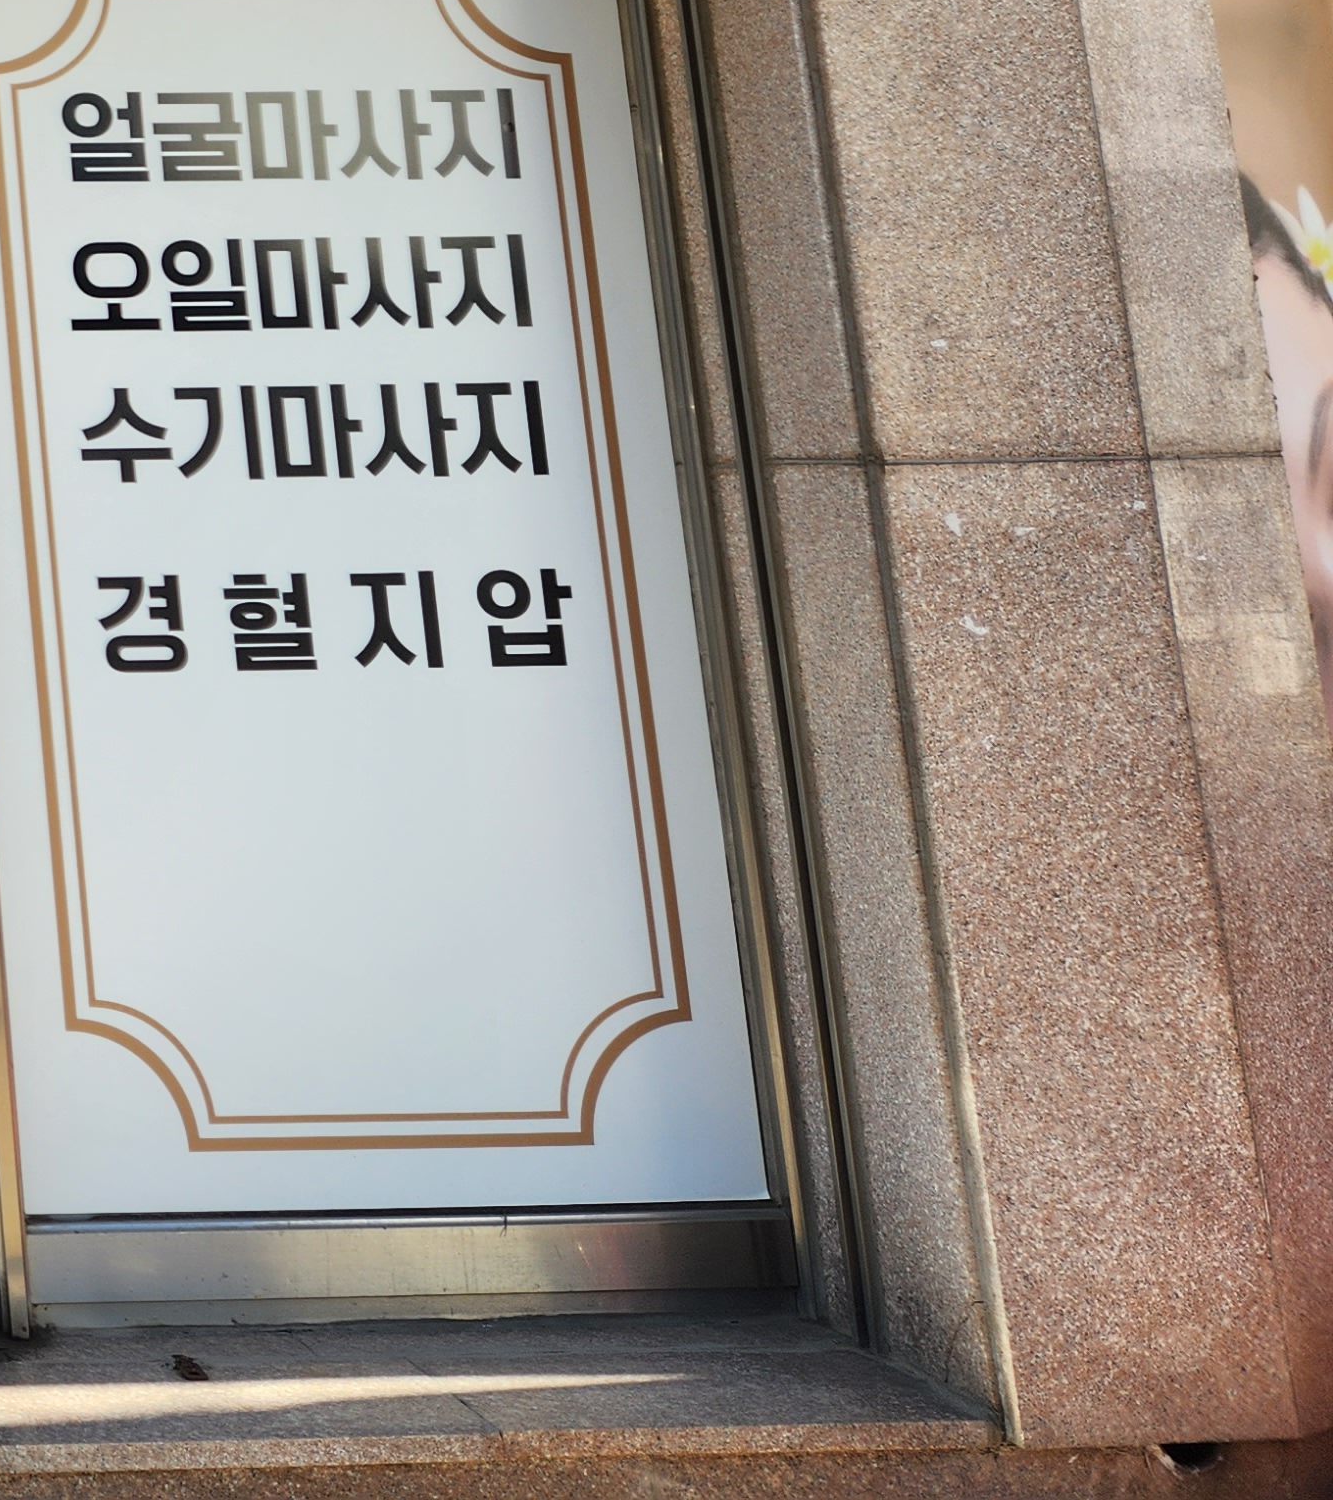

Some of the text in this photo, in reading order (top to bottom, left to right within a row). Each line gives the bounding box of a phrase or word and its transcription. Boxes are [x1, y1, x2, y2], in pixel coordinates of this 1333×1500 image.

[61, 87, 523, 183] 얼굴마사지
[70, 233, 535, 333] 오일마사지
[79, 380, 550, 484] 수기마사지
